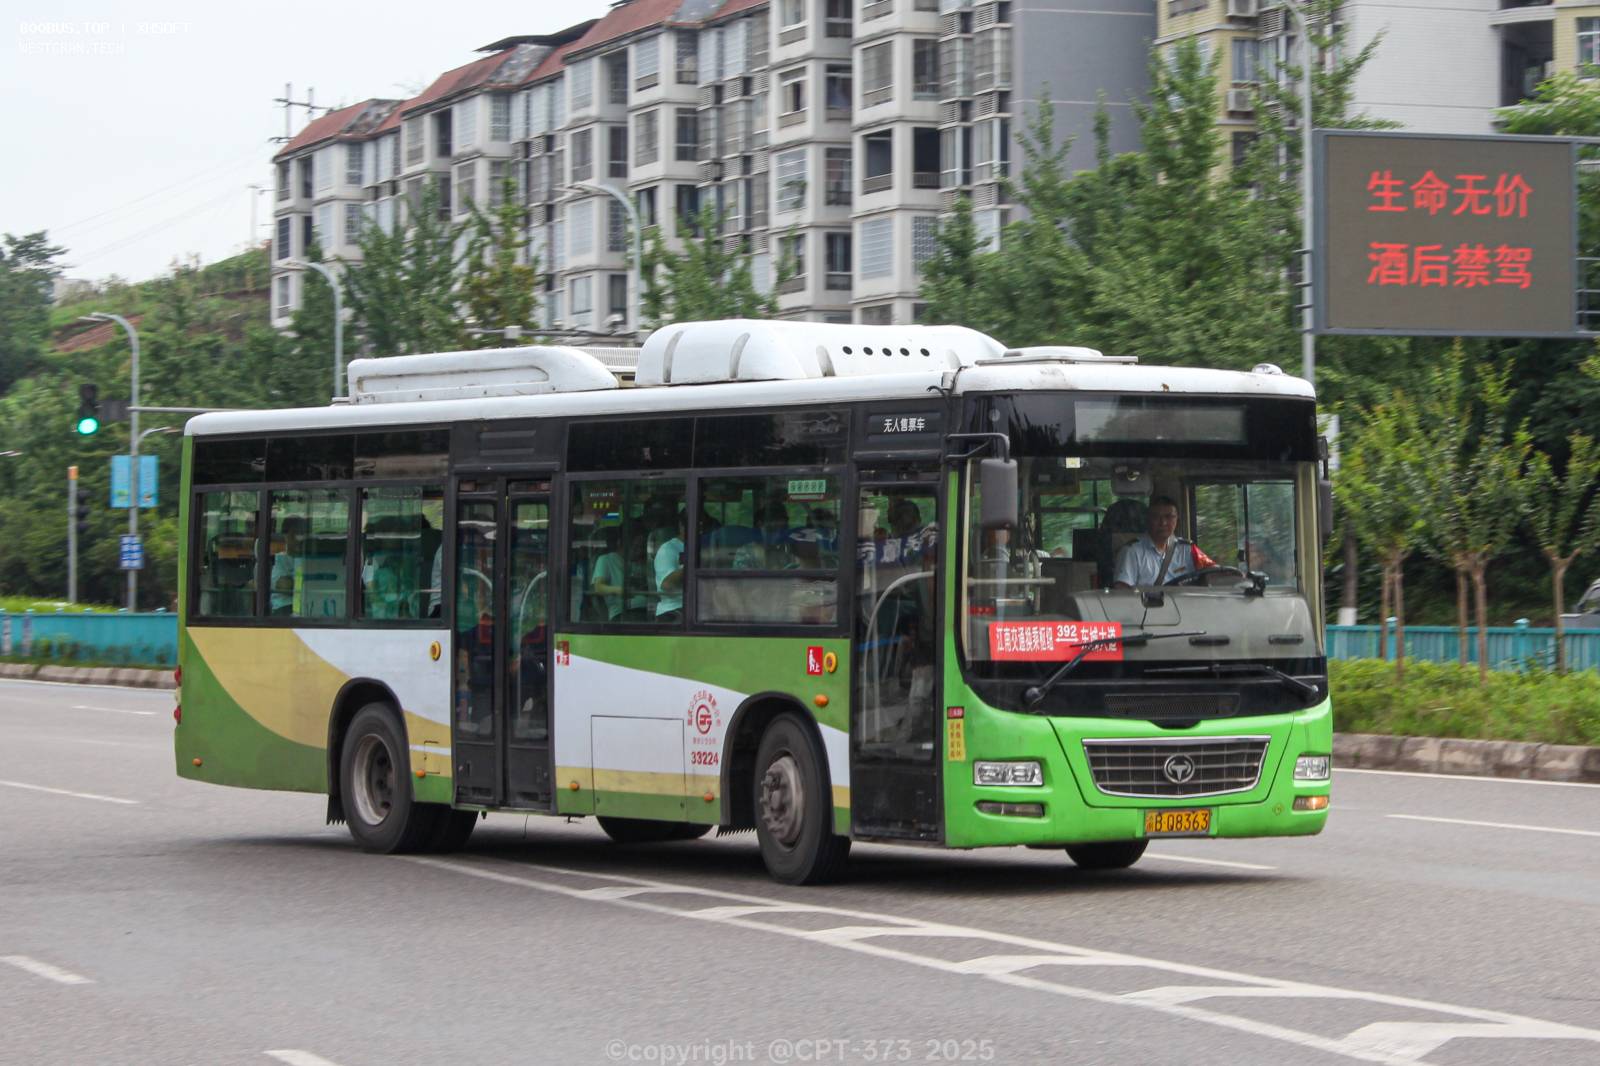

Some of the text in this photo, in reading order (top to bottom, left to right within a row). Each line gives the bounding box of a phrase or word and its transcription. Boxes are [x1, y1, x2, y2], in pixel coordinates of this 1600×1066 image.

[1366, 170, 1533, 218] 生命无价
[1366, 241, 1533, 289] 酒后禁驾
[883, 417, 926, 433] 无人售票车
[1057, 624, 1077, 637] 392
[691, 751, 720, 766] 33224
